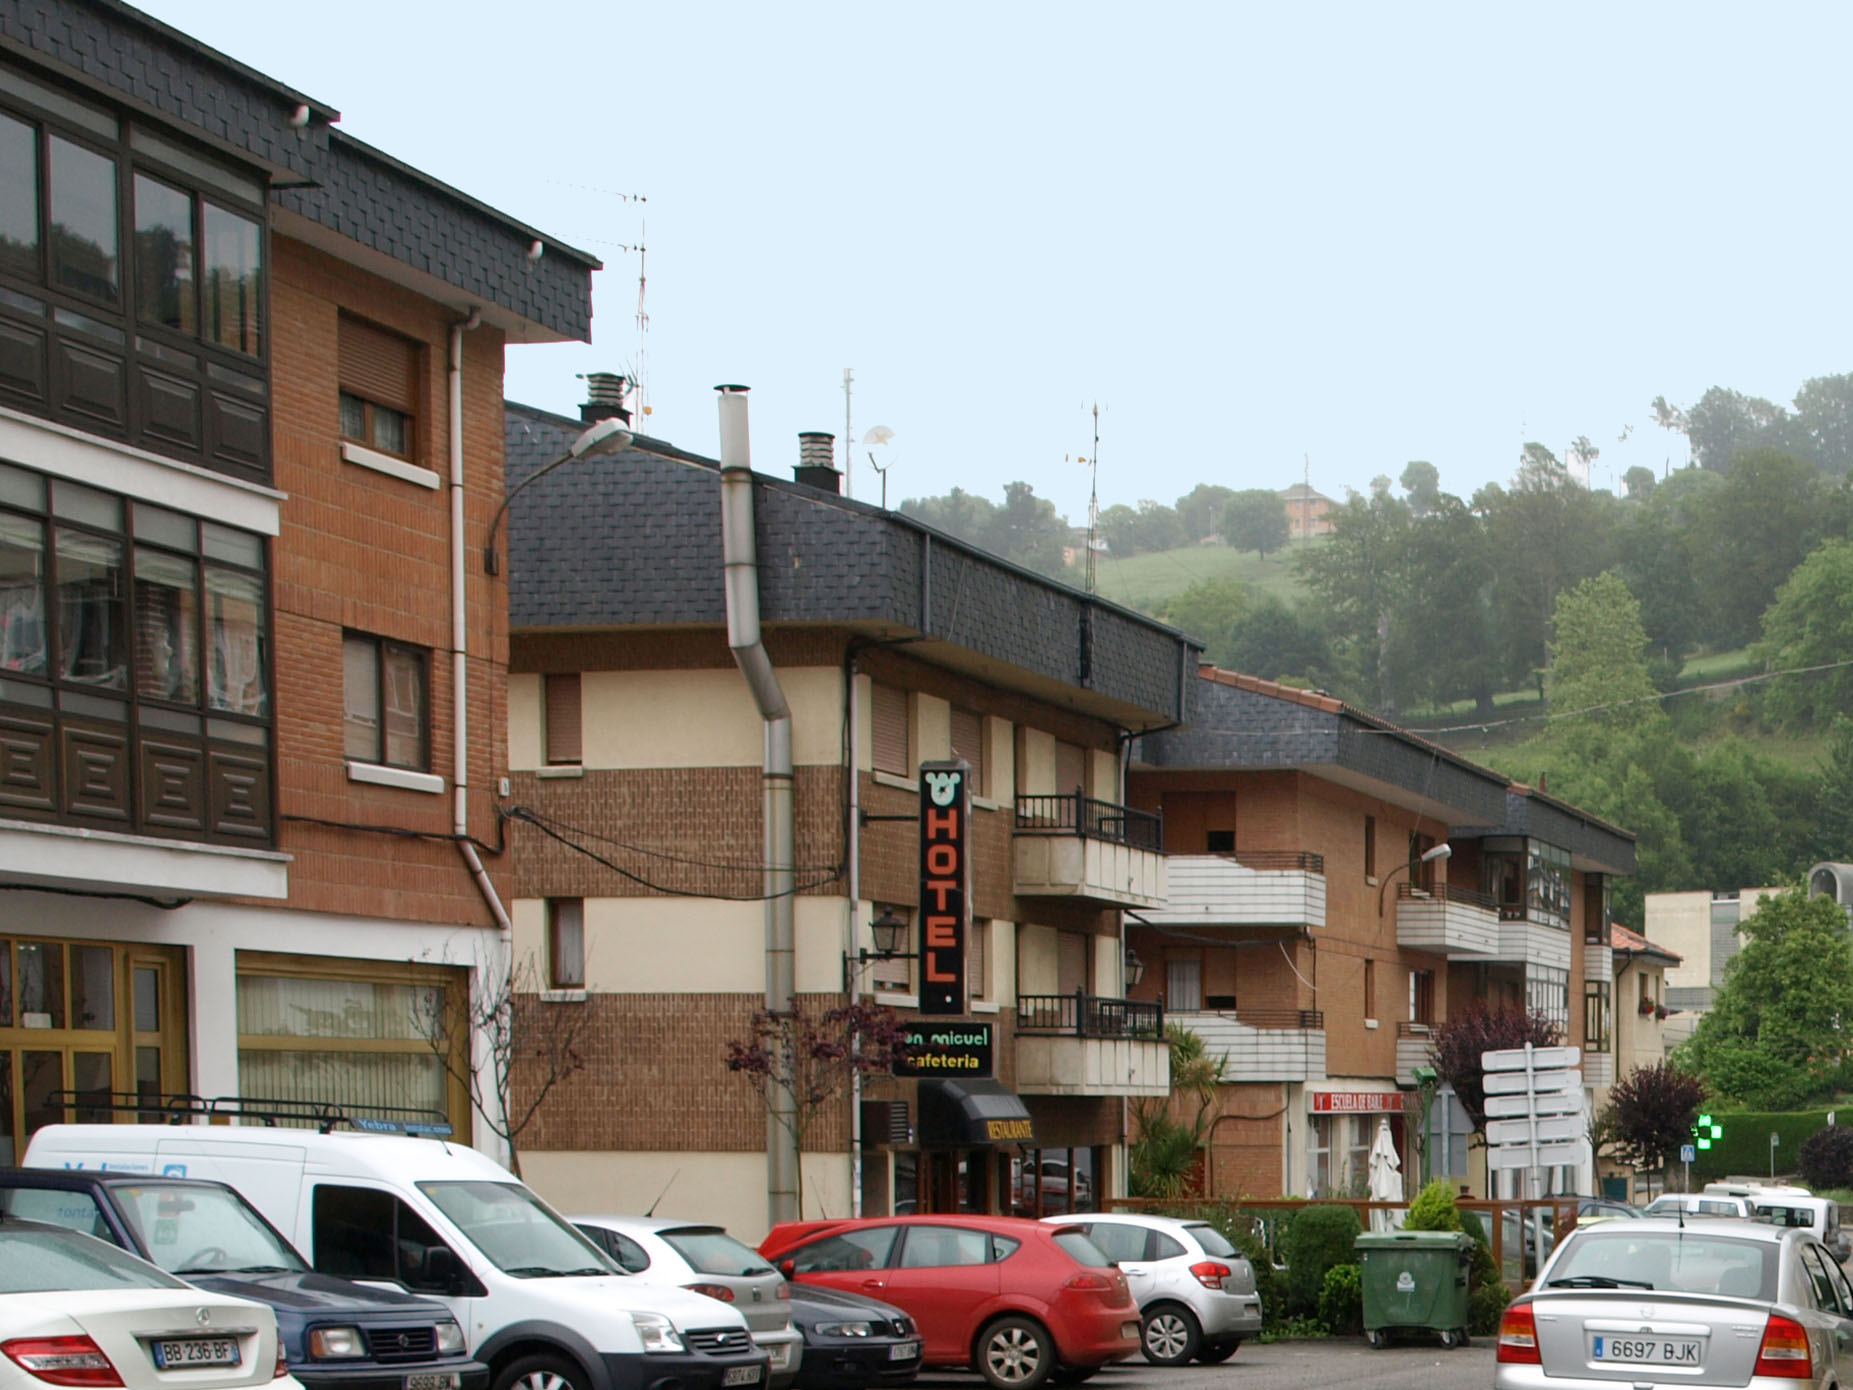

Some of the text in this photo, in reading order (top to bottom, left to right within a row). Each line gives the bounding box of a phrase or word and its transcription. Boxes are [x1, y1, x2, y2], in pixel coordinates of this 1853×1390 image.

[927, 808, 957, 982] HOTEL
[987, 1119, 1033, 1140] RESTAURANTE
[1612, 1340, 1697, 1361] 6697 BJK
